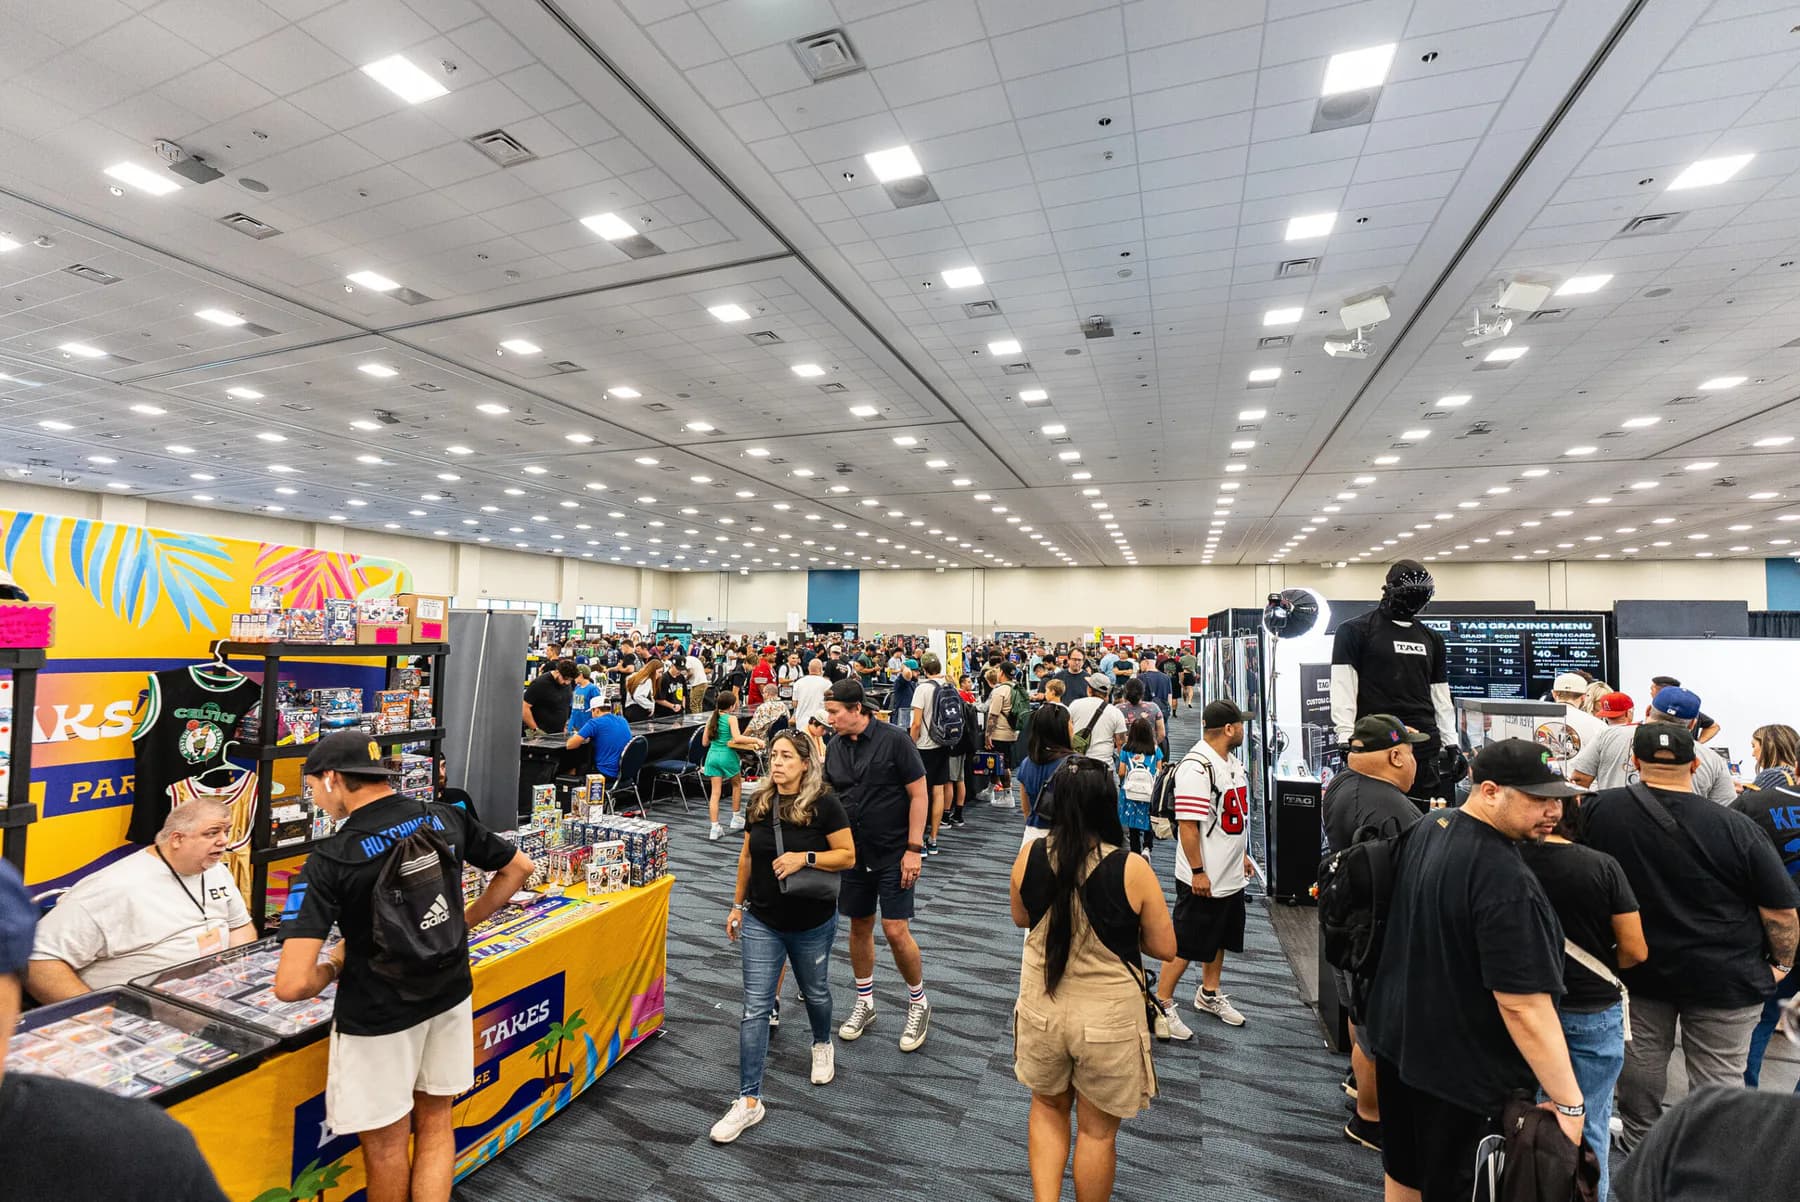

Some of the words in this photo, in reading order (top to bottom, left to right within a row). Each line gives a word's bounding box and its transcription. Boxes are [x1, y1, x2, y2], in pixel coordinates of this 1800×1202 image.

[1461, 622, 1487, 630] TAG
[1488, 622, 1549, 630] GRADING
[1551, 622, 1593, 630] MENU
[1397, 643, 1424, 653] TAG
[1533, 649, 1552, 658] $40
[1318, 681, 1329, 689] TAG
[1306, 697, 1326, 706] CUSTOM
[283, 713, 318, 723] RECON
[1286, 796, 1313, 805] TAG
[480, 998, 550, 1050] TAKES
